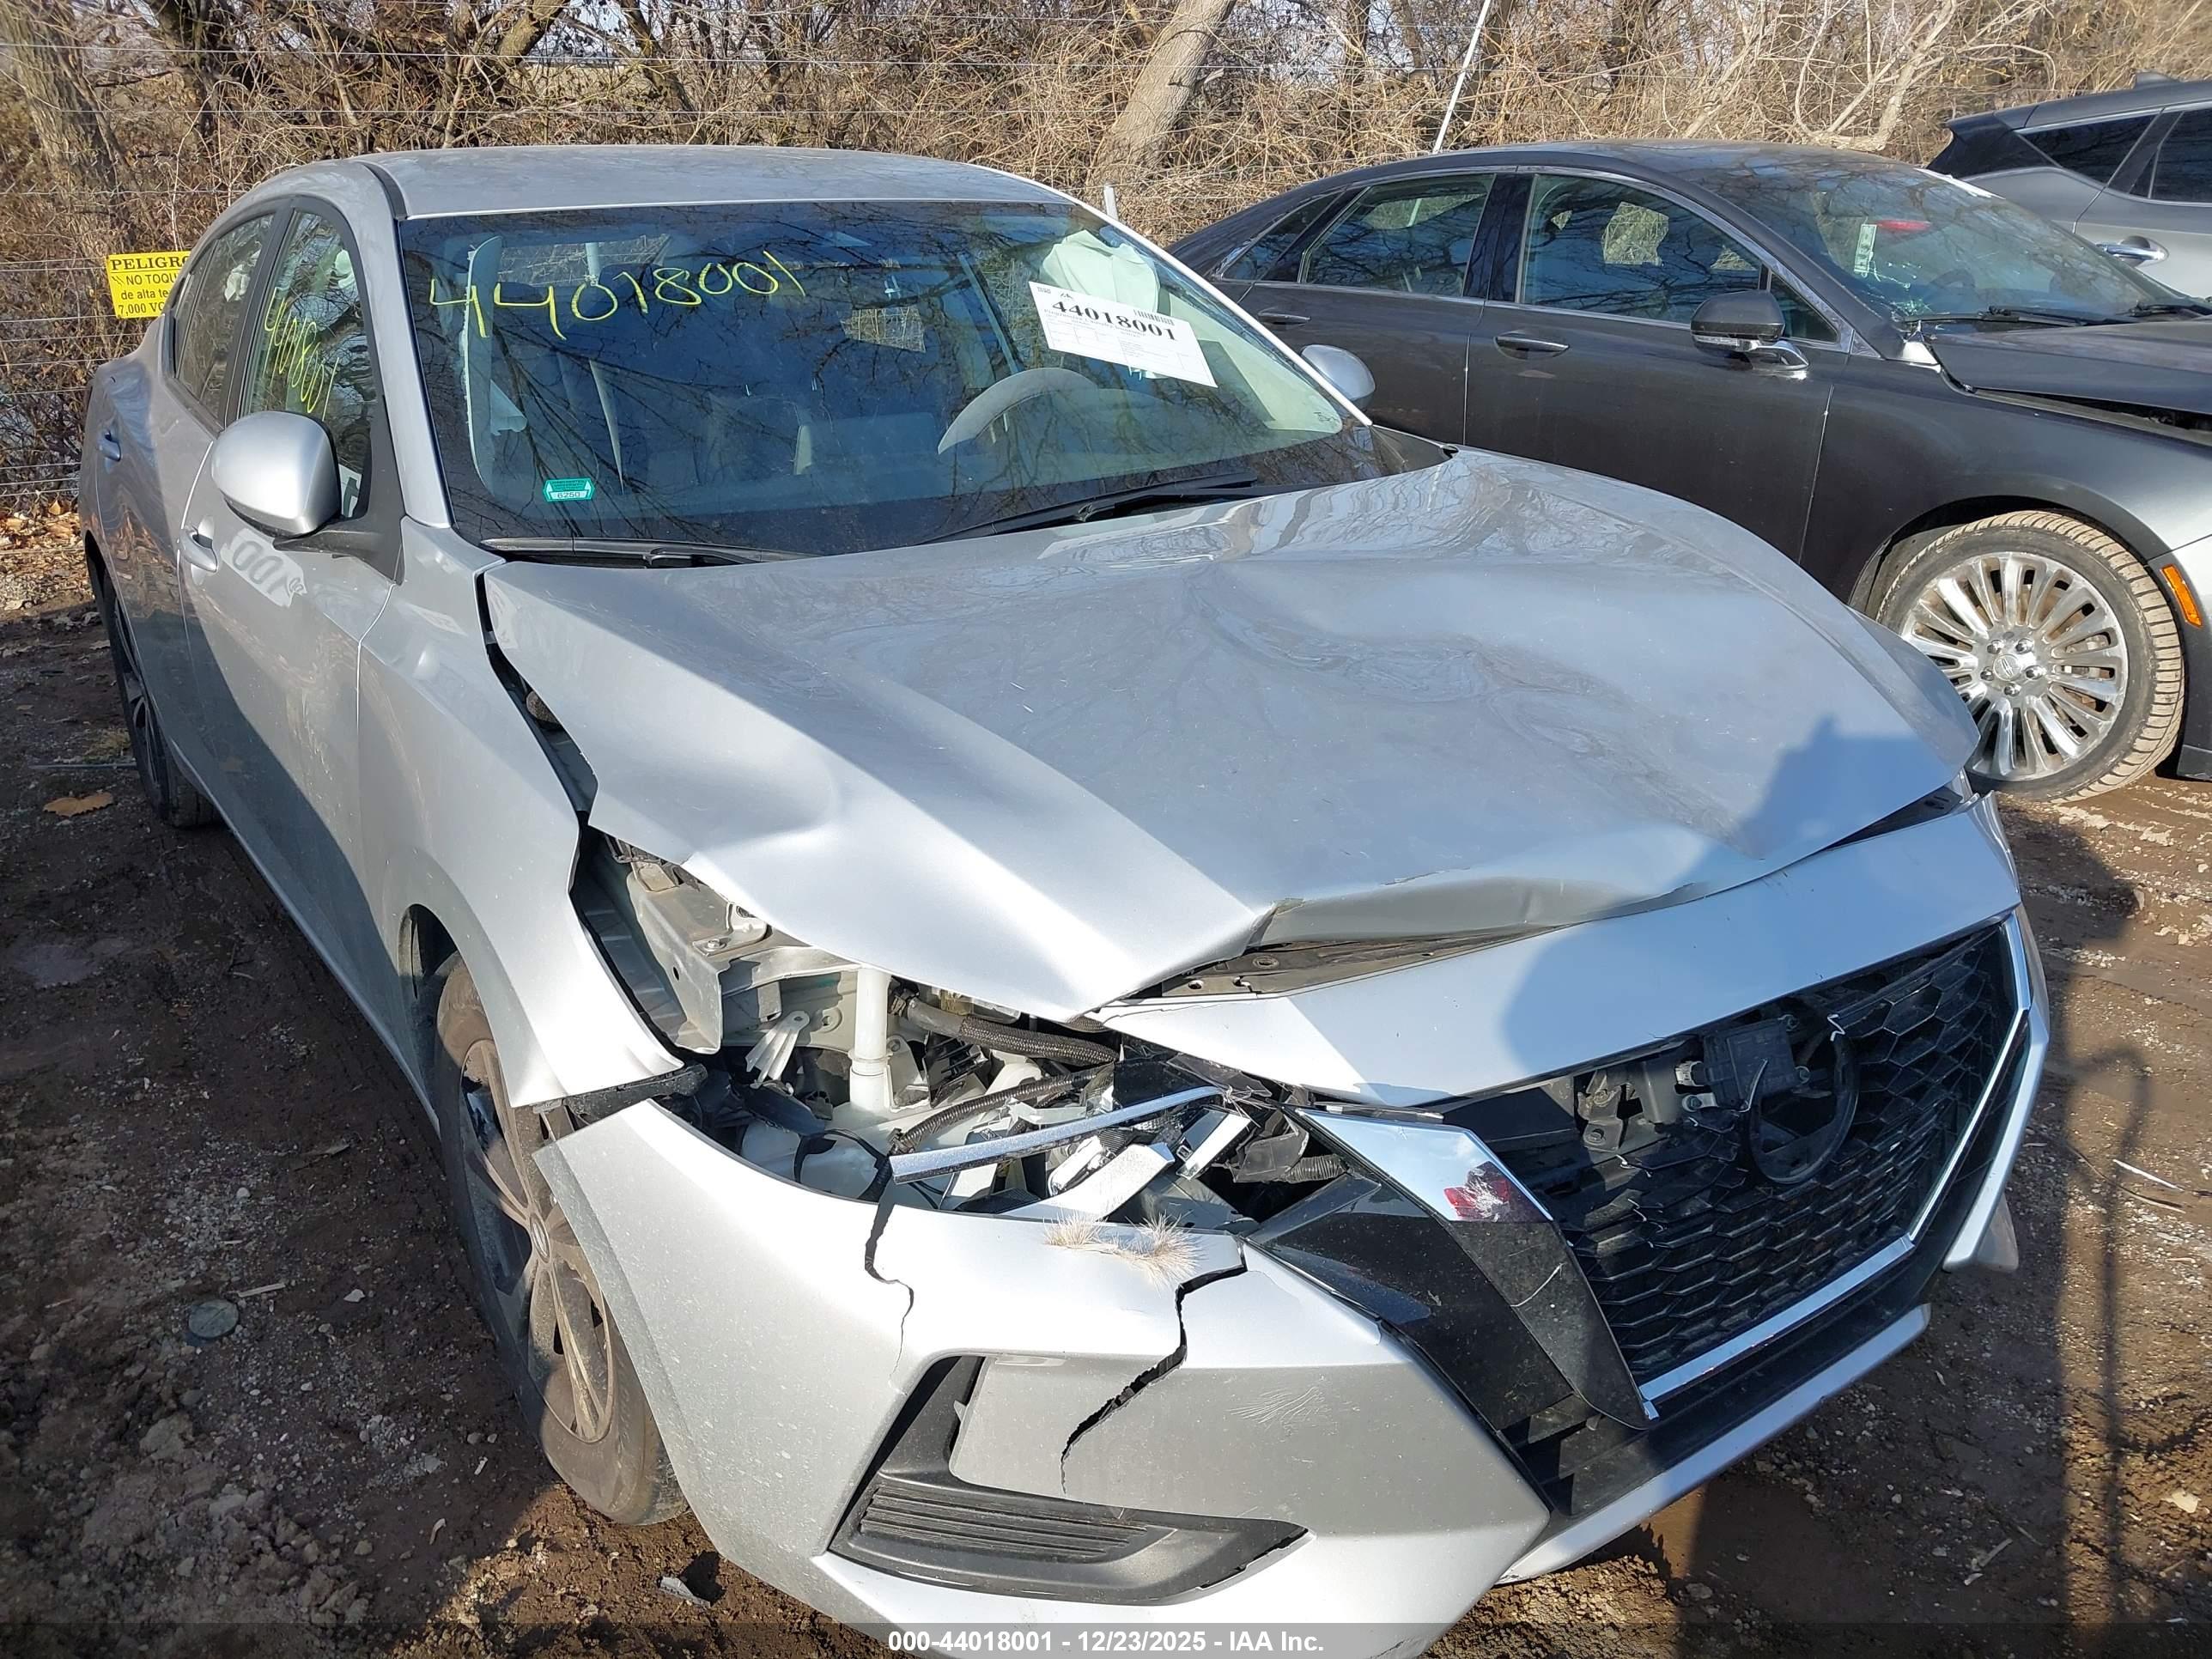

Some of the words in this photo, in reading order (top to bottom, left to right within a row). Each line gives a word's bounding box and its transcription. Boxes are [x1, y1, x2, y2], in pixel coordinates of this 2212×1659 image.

[125, 275, 143, 286] NO
[121, 290, 134, 301] de
[137, 289, 156, 300] alta
[429, 249, 806, 340] 44018001
[118, 301, 147, 317] 7,000
[1052, 301, 1179, 342] 44018001
